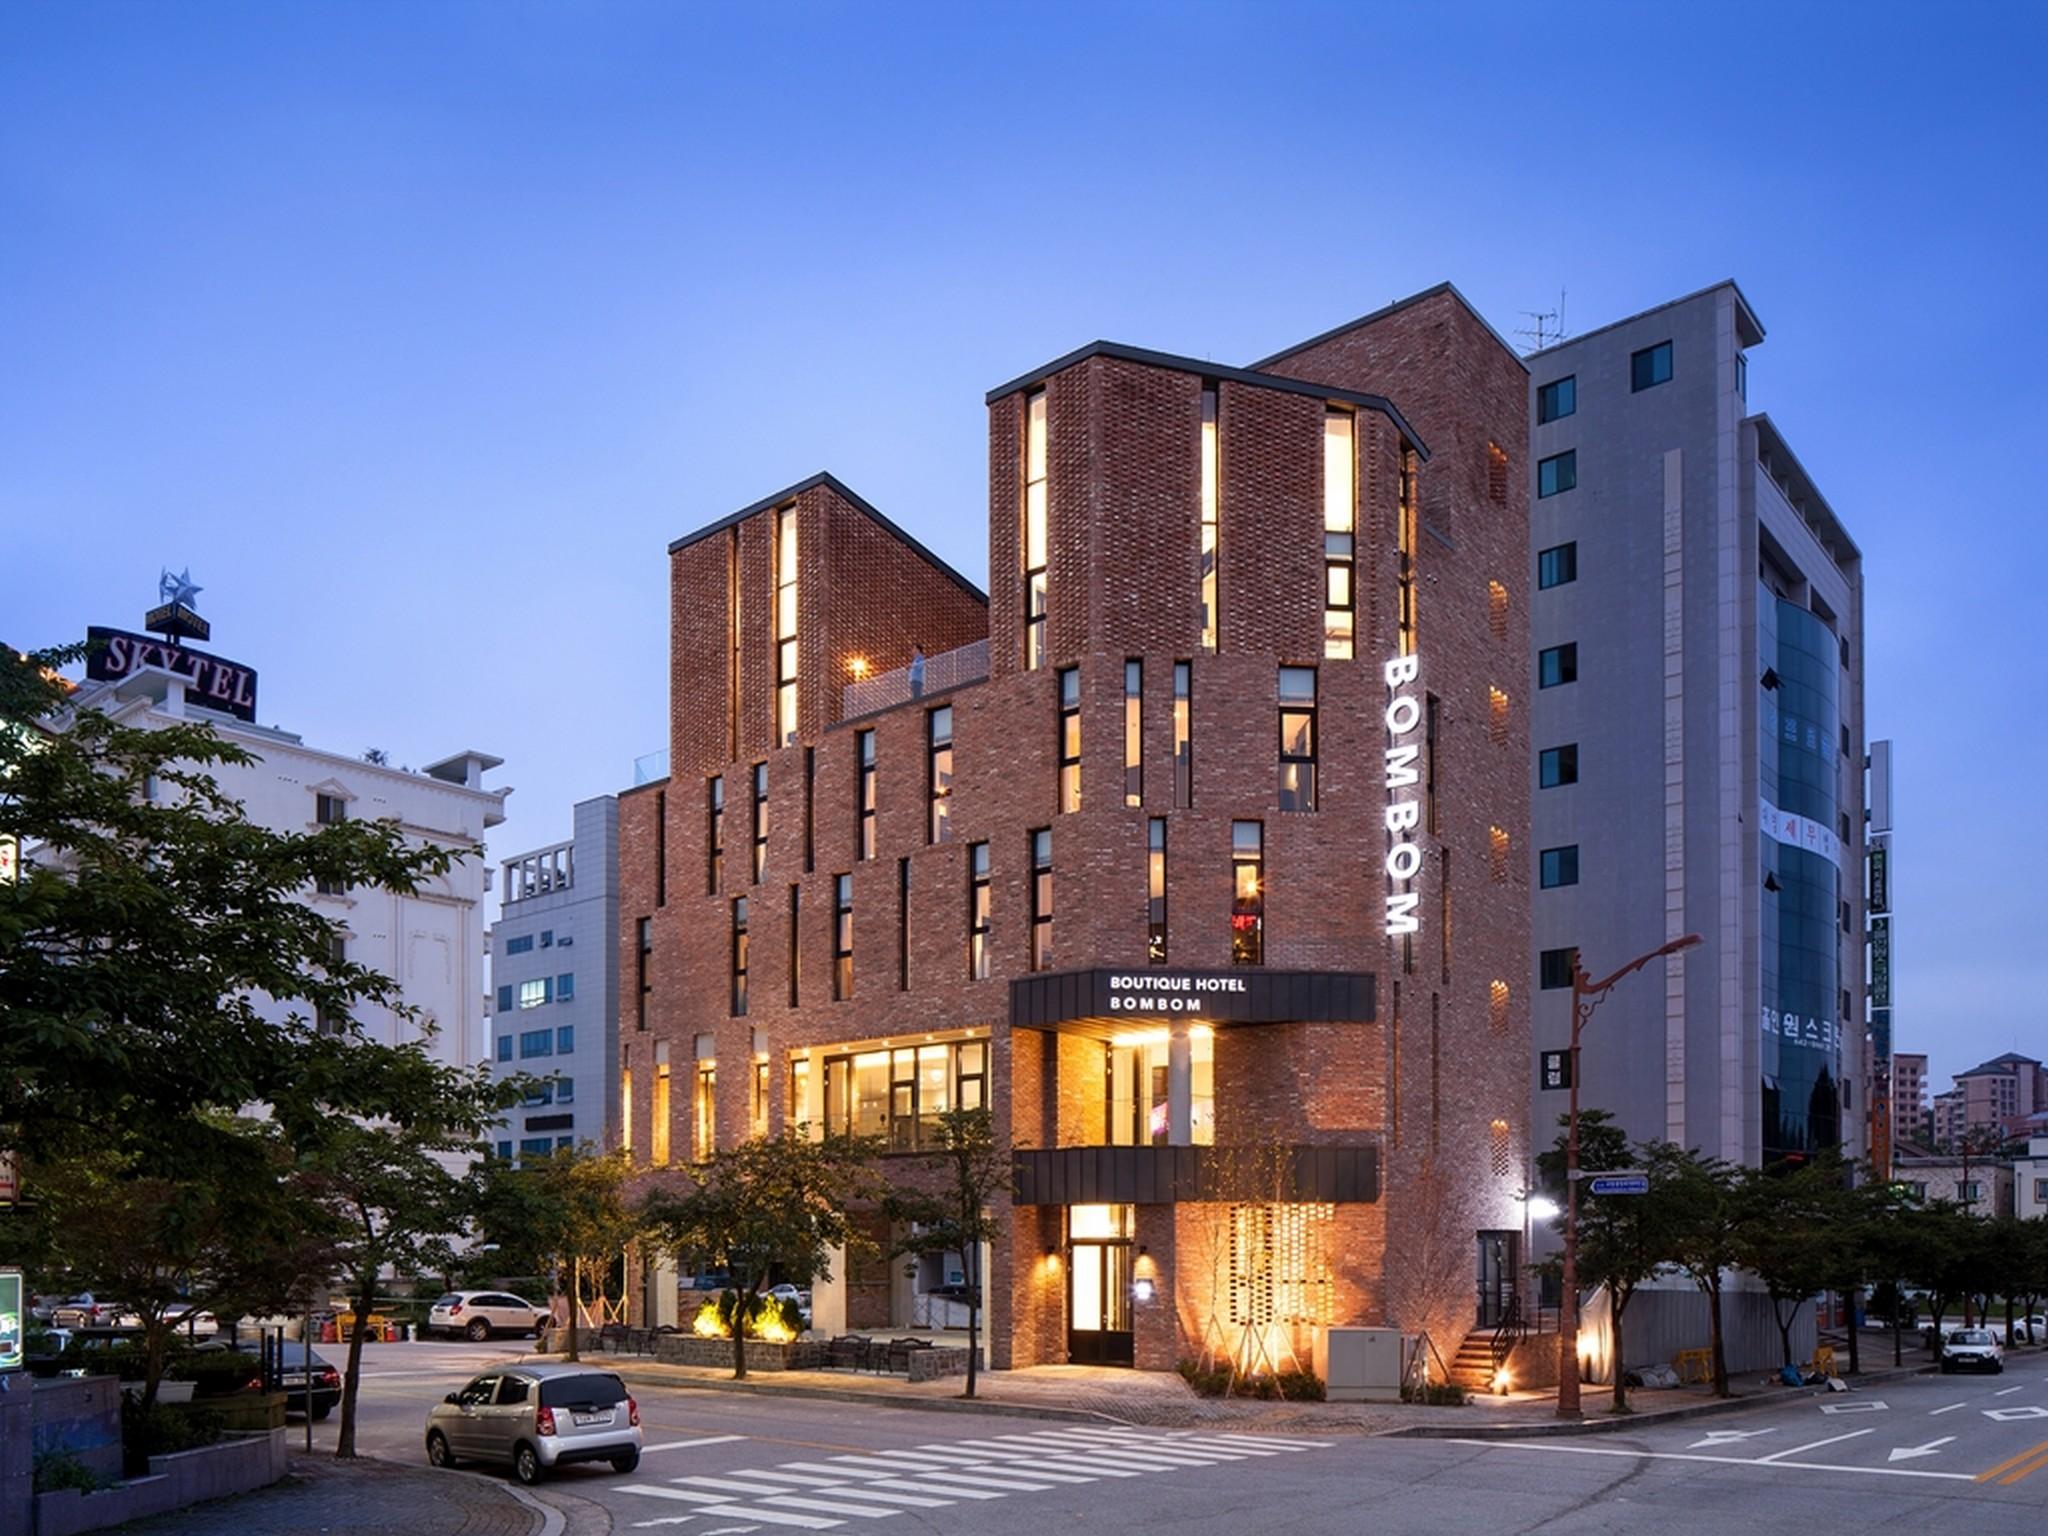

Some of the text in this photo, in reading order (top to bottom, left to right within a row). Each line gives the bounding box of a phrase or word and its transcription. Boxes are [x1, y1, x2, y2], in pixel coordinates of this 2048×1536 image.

[105, 636, 253, 707] SKYTEL
[1385, 654, 1420, 935] BOMBOM
[1110, 976, 1246, 992] BOUTIQUE HOTEL
[1110, 997, 1201, 1011] BOMBOM
